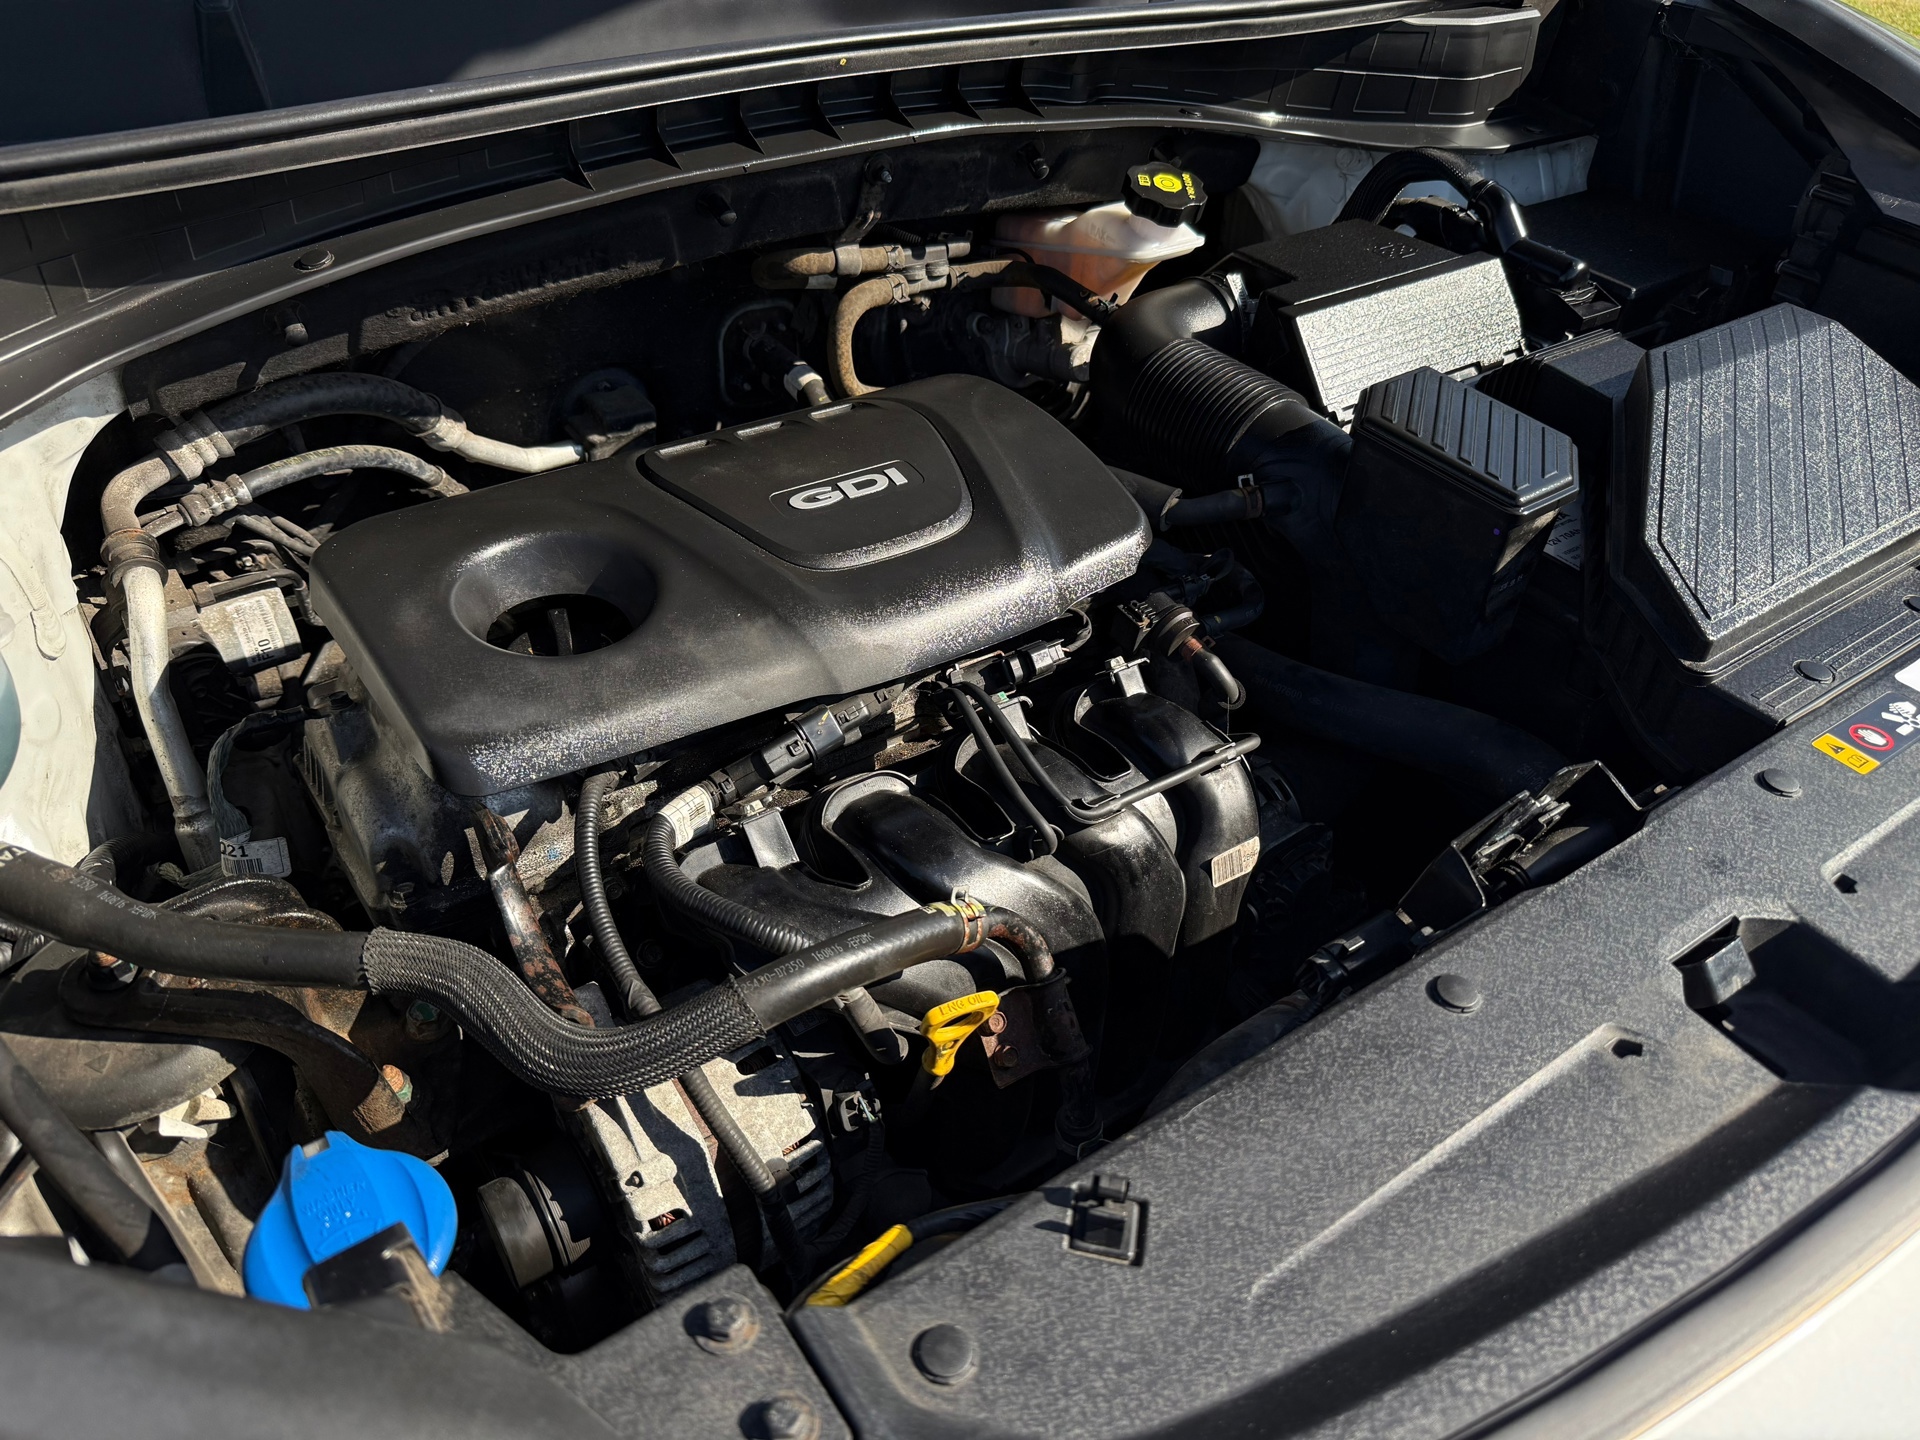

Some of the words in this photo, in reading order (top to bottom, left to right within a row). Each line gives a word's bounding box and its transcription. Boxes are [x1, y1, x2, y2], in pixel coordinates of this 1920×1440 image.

[788, 467, 908, 510] GDI
[257, 638, 275, 661] F10
[97, 889, 130, 909] 160816
[811, 942, 843, 962] 160816
[967, 993, 988, 1006] OIL
